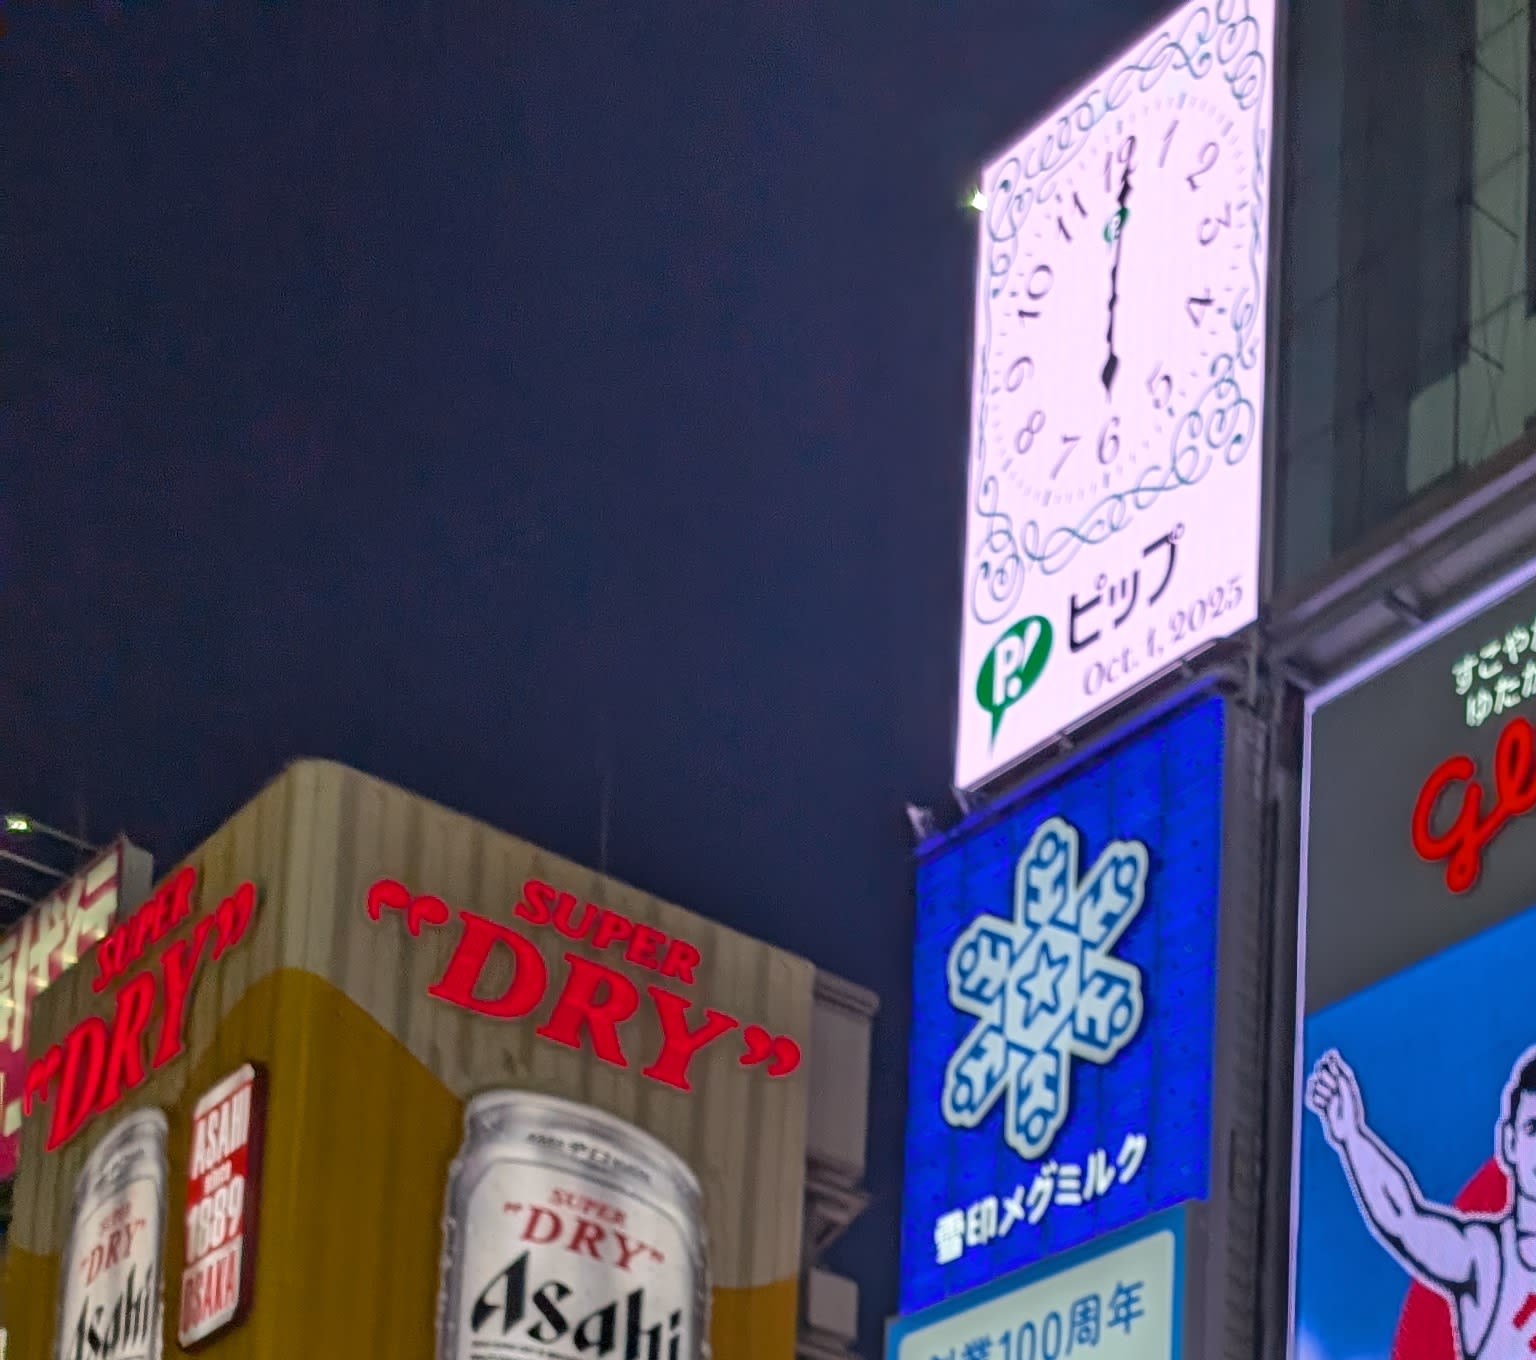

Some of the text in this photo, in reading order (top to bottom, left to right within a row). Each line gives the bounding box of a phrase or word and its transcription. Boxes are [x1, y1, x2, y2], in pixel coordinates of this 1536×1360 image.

[1070, 523, 1186, 653] ピップ
[1083, 645, 1140, 697] Oct.
[1169, 572, 1244, 642] 2025
[92, 865, 197, 993] SUPER
[514, 878, 701, 985] SUPER
[191, 1082, 251, 1181] ASAHI
[184, 1174, 246, 1265] 1889
[551, 1187, 628, 1227] SUPER
[934, 1134, 1148, 1265] 雪印メグミルク
[181, 1246, 238, 1332] OSAKA
